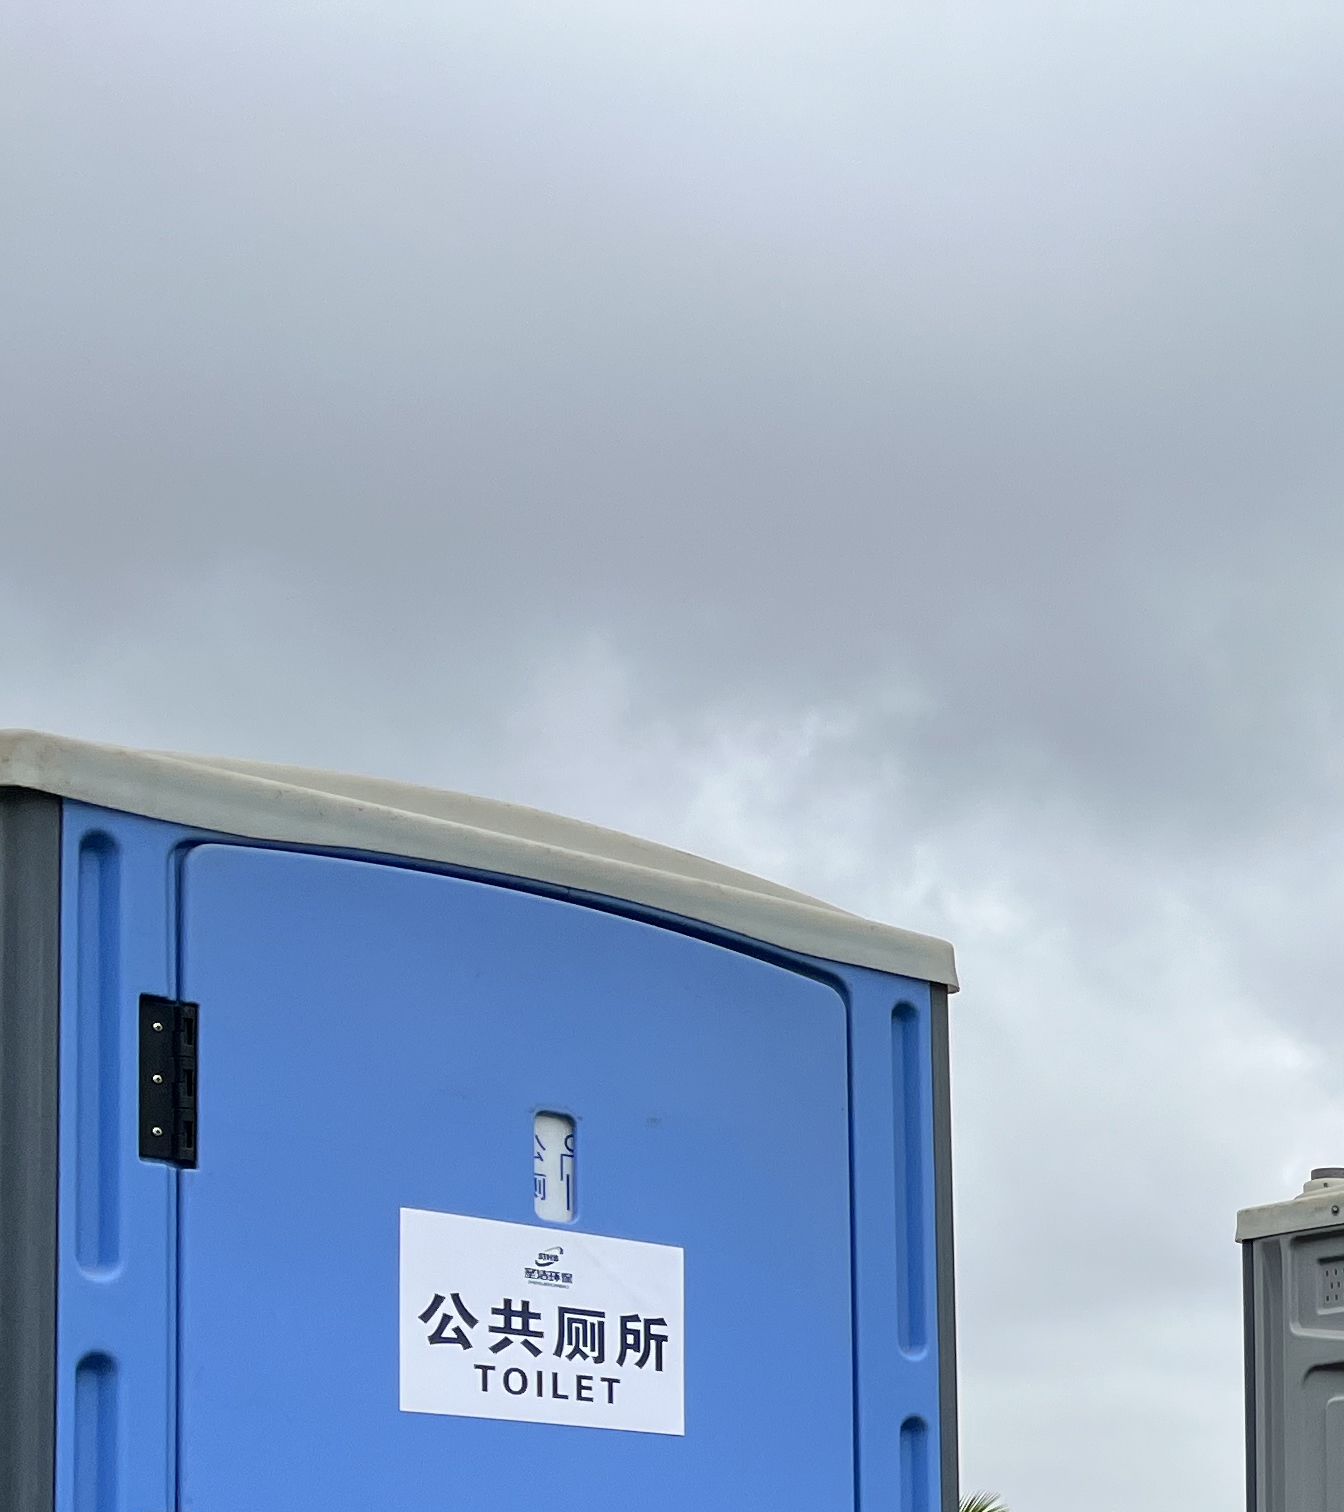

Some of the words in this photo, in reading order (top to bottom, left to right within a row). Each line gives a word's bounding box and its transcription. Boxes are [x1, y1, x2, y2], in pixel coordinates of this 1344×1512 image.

[418, 1292, 670, 1372] 公共厕所
[474, 1364, 622, 1405] TOILET
